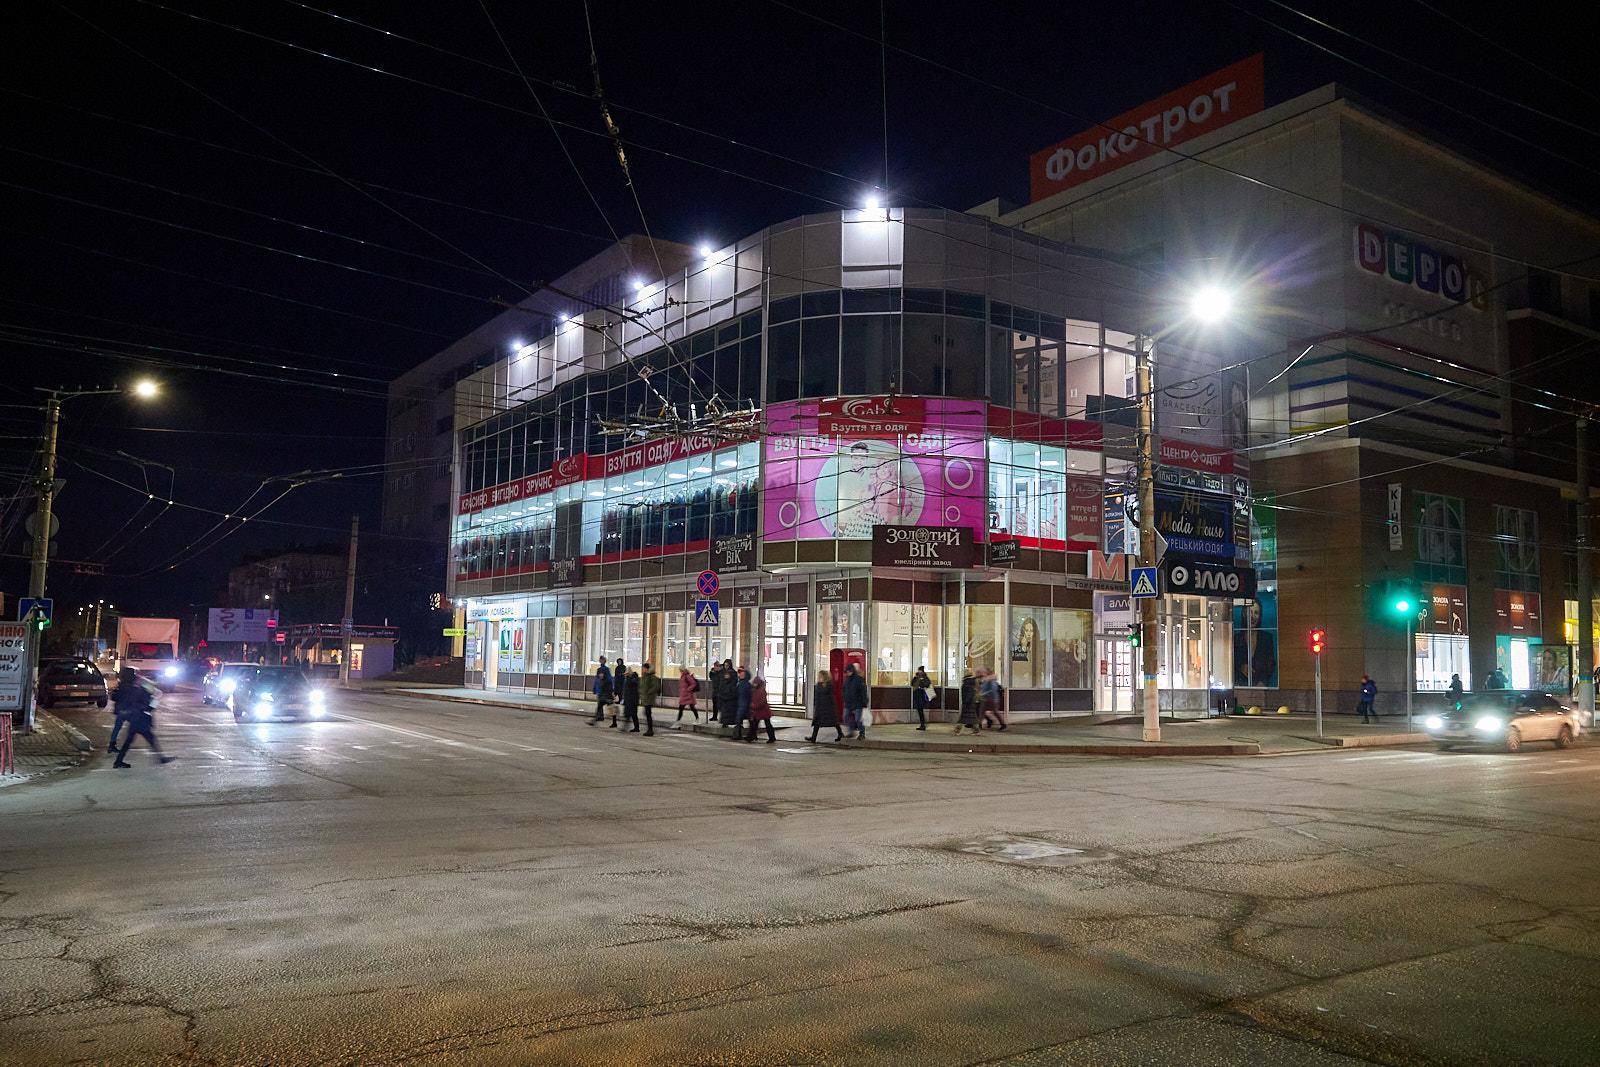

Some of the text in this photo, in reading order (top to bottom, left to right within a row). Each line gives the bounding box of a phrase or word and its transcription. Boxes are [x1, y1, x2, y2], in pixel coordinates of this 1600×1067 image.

[831, 423, 867, 432] Взуття
[608, 450, 642, 472] ВЗУТТЯ
[648, 440, 676, 463] ОДЯГ
[1163, 447, 1190, 460] ЦЕНТР
